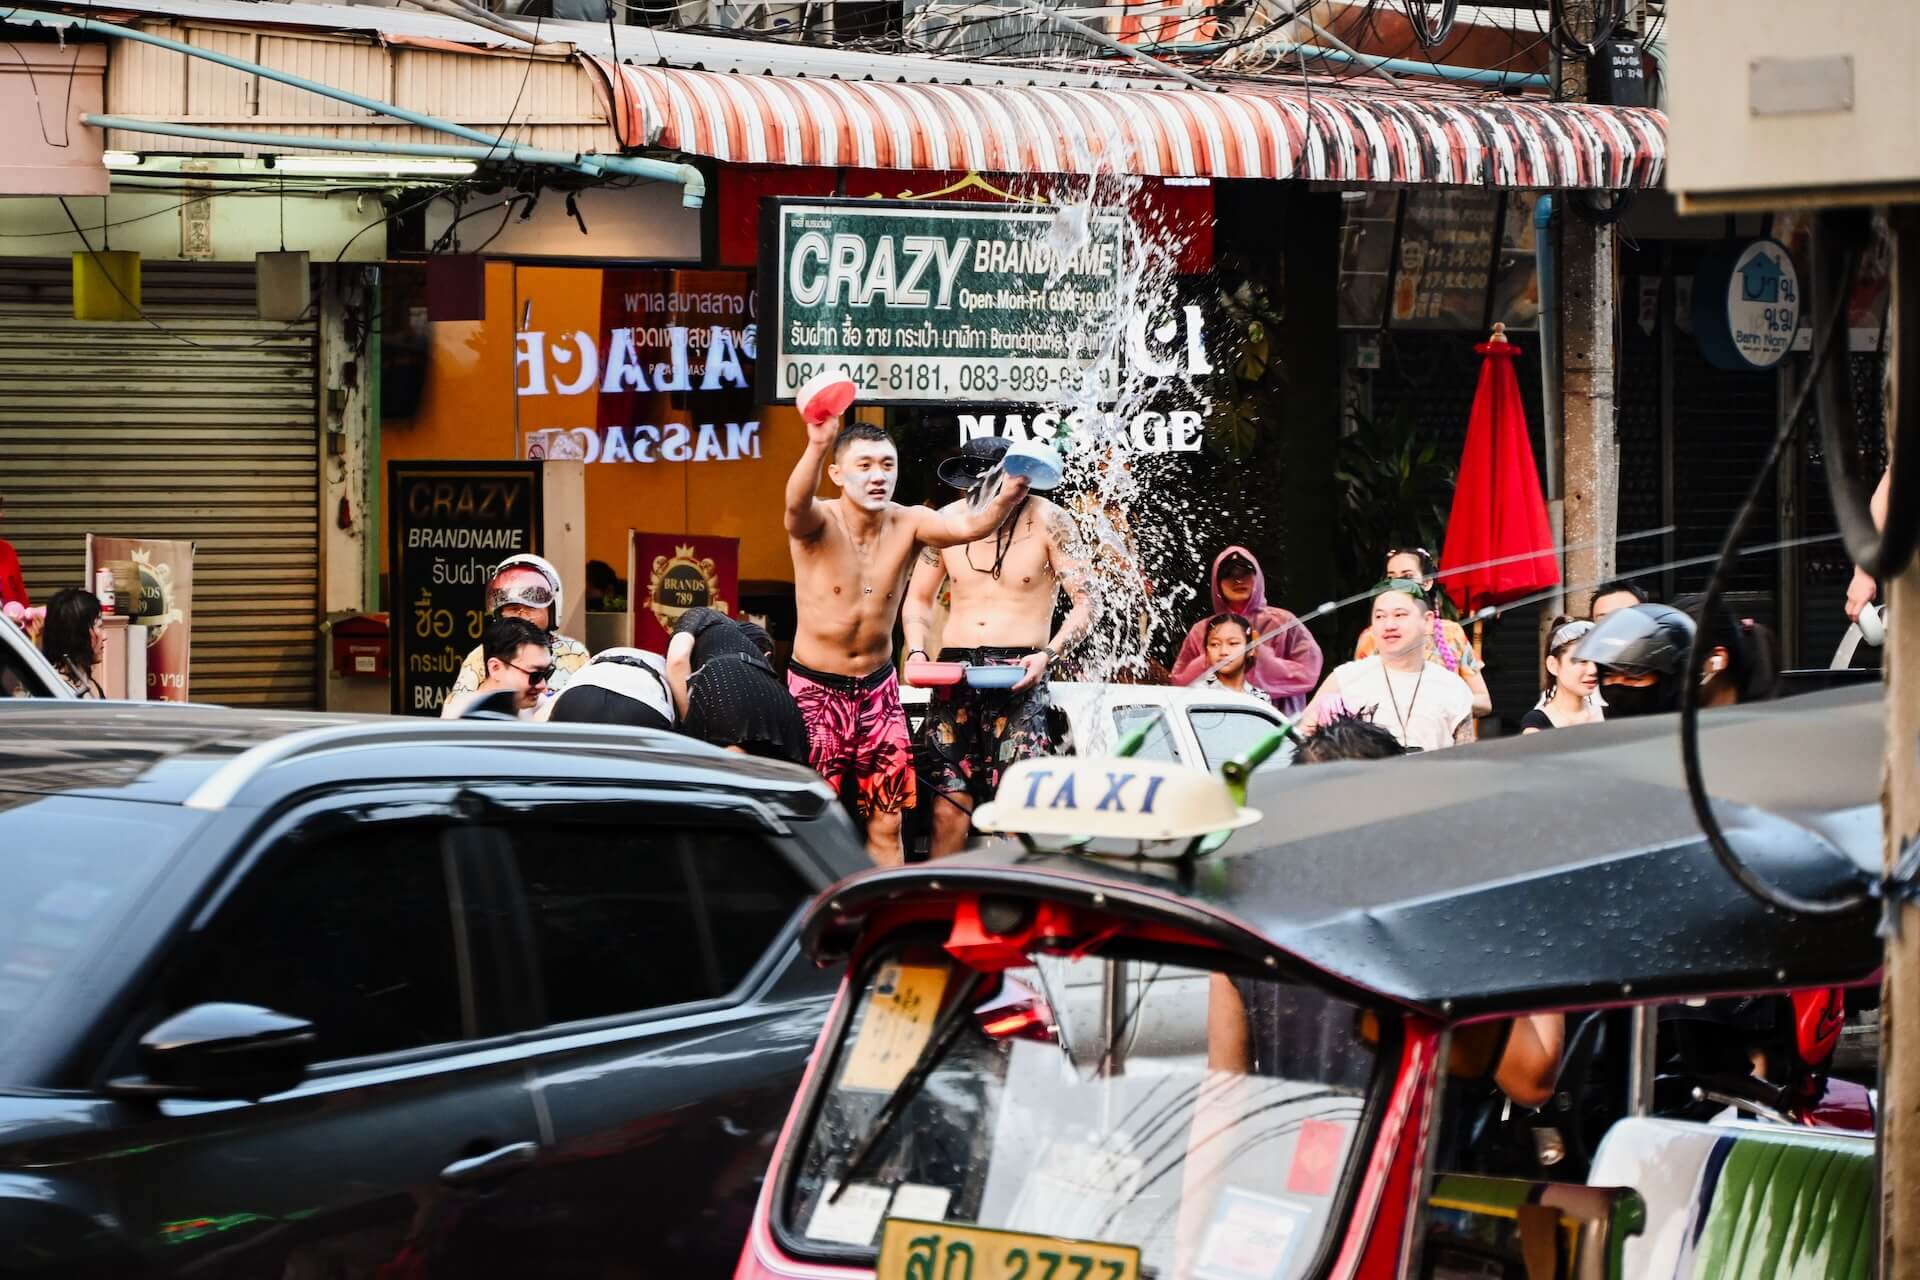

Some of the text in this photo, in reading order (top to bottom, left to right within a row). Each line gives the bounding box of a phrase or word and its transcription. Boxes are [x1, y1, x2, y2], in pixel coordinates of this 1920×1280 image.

[790, 231, 971, 309] CRAZY
[959, 288, 993, 313] Open
[790, 319, 837, 347] รับฝาก
[842, 314, 862, 347] ซื้อ
[866, 327, 892, 348] ขาย
[958, 411, 1203, 452] MASGE
[408, 481, 520, 519] CRAZY
[408, 528, 523, 549] BRANDNAME
[664, 578, 705, 591] BRANDS
[675, 592, 693, 604] 789
[1022, 770, 1165, 814] TAXI
